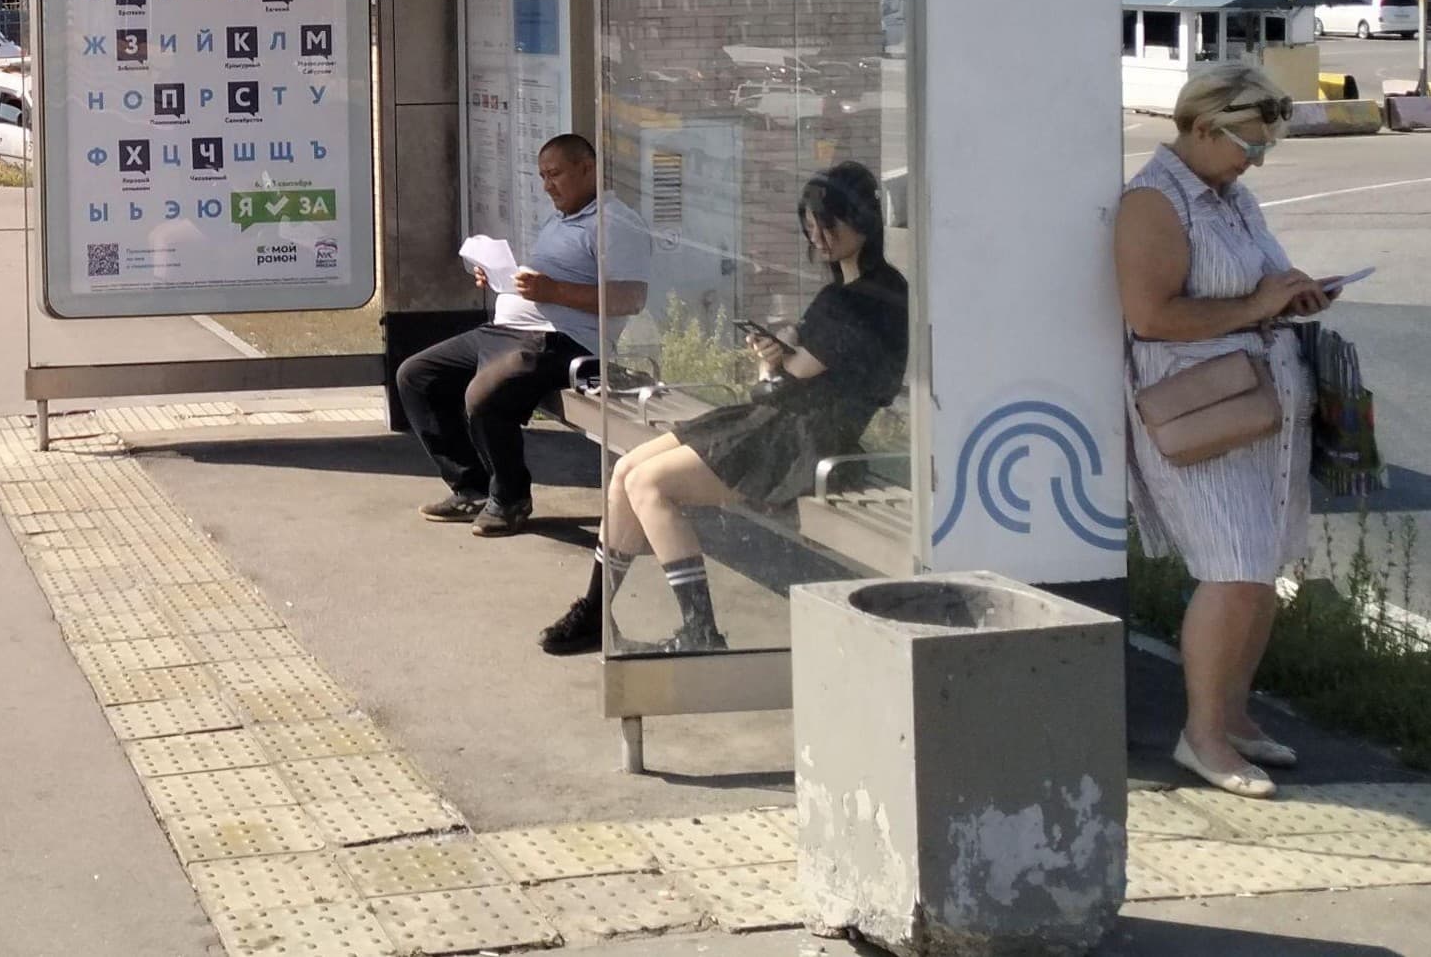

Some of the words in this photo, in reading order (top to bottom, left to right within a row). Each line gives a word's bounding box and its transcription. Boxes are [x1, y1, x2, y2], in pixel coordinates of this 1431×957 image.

[83, 36, 106, 55] Ж
[124, 34, 138, 54] З
[160, 34, 176, 52] И
[197, 28, 214, 52] Й
[234, 32, 250, 52] К
[270, 32, 286, 50] Л
[306, 31, 326, 50] М
[88, 92, 104, 110] Н
[123, 90, 143, 110] О
[162, 90, 177, 108] П
[200, 88, 214, 108] Р
[234, 87, 251, 106] С
[272, 86, 287, 105] Т
[310, 86, 326, 104] У
[86, 146, 108, 166] Ф
[126, 146, 143, 166] Х
[163, 144, 182, 166] Ц
[199, 144, 215, 163] Ч
[234, 142, 256, 162] Ш
[270, 142, 294, 164] Щ
[310, 140, 327, 160] Ъ
[90, 202, 108, 222] Ы
[130, 202, 143, 220] Ь
[164, 200, 180, 220] Э
[198, 198, 222, 218] Ю
[239, 197, 253, 217] Я
[298, 196, 330, 214] ЗА
[271, 242, 297, 253] мой
